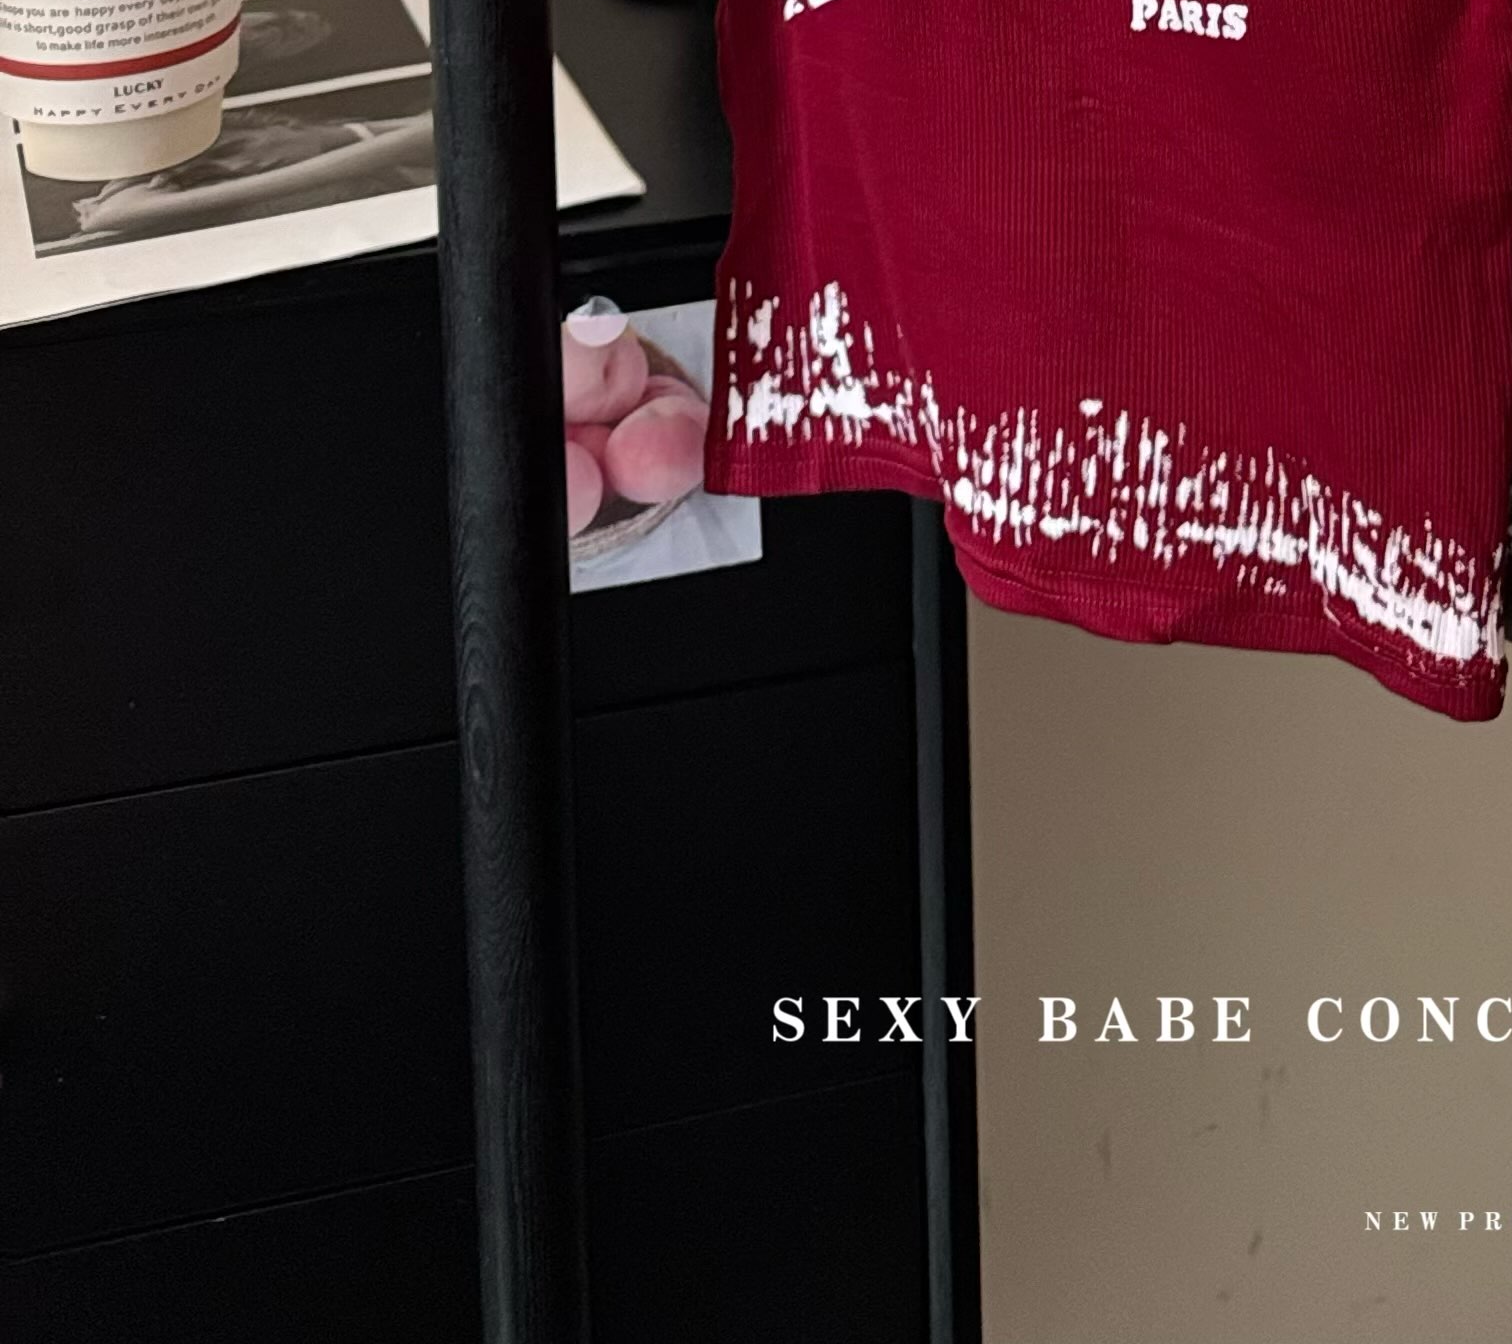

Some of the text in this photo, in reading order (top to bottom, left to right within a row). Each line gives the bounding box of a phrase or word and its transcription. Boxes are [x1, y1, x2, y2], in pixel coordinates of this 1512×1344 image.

[26, 7, 46, 19] you
[49, 8, 70, 18] are
[74, 5, 115, 17] happy
[118, 0, 154, 13] every
[95, 18, 136, 35] grasp
[138, 13, 153, 26] of
[49, 40, 82, 51] make
[84, 40, 105, 50] life
[108, 36, 142, 48] more
[113, 78, 164, 98] LUCKY
[33, 105, 102, 117] HAPPY
[114, 91, 187, 114] EVERY
